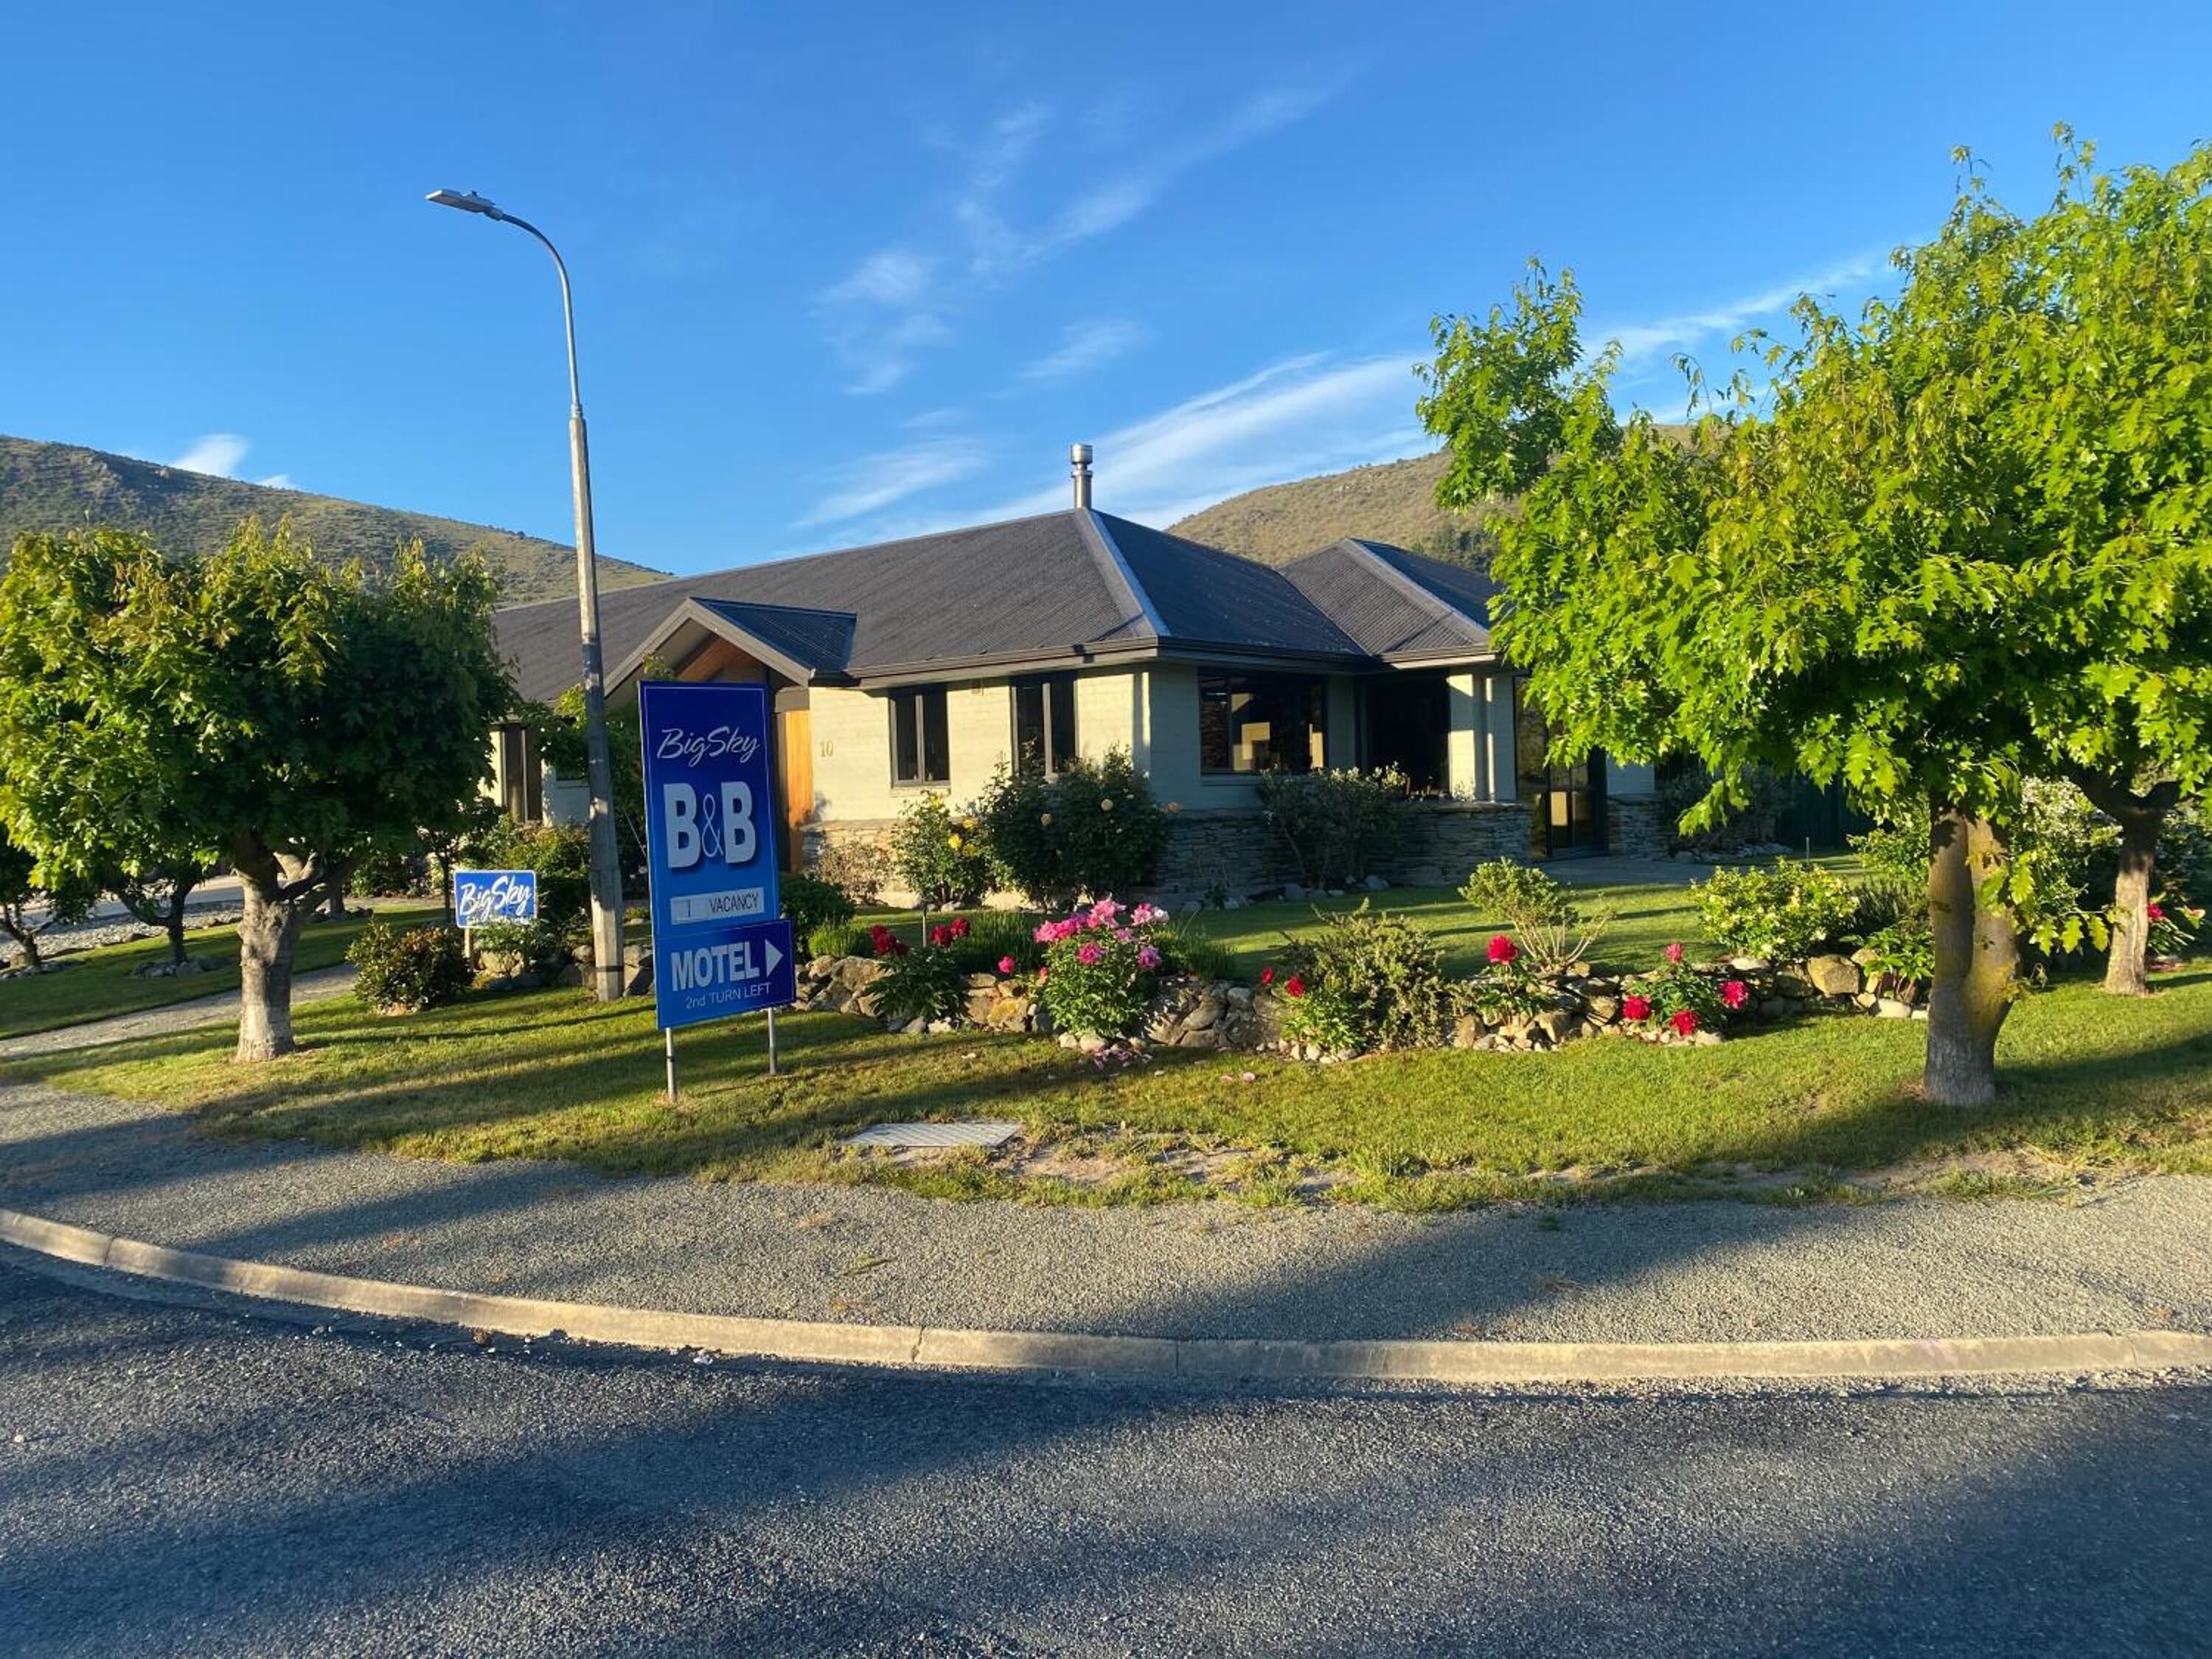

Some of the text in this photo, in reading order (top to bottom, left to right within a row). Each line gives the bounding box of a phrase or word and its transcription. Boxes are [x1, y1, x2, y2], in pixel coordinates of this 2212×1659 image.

[819, 740, 834, 757] 10
[663, 781, 757, 869] B&B
[709, 892, 759, 914] VACANCY
[671, 941, 760, 992] MOTEL
[685, 981, 772, 1009] 2nd TURN LEFT
